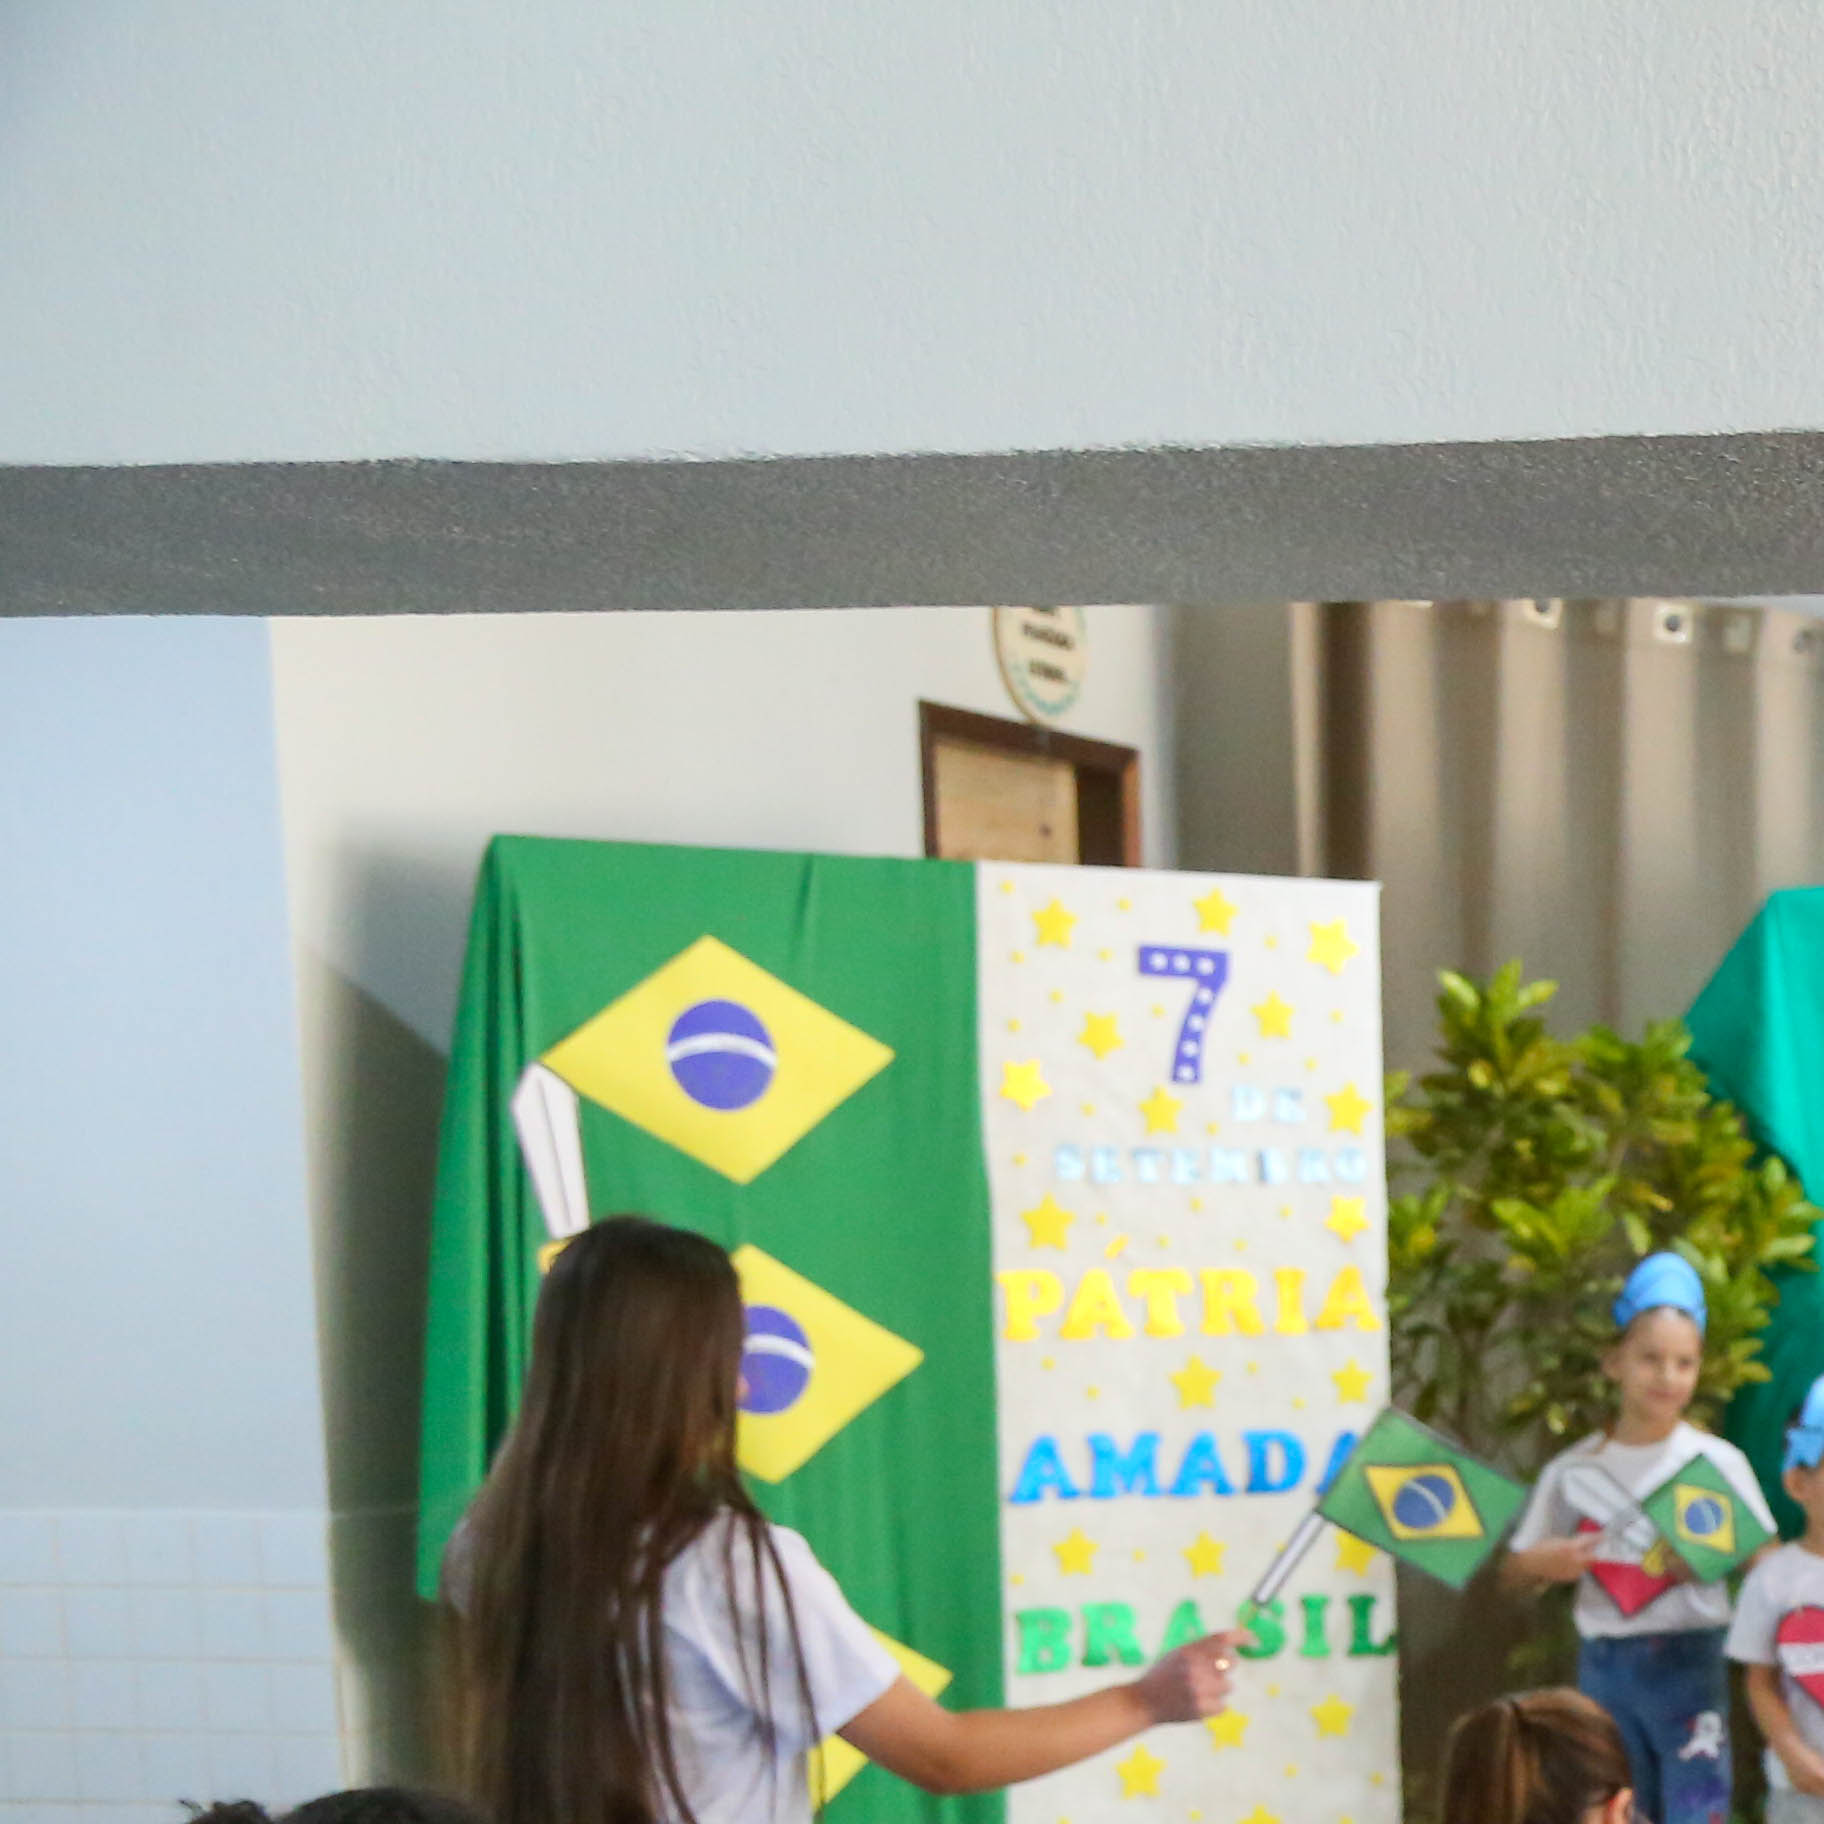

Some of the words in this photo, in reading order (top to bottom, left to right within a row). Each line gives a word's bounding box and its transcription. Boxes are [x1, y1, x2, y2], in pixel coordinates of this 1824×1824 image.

[1137, 944, 1231, 1084] 7
[1230, 1084, 1307, 1125] DE
[1054, 1142, 1368, 1187] SETEMBRO
[997, 1233, 1382, 1341] PÁTRIA
[1014, 1593, 1398, 1675] BRASIL
